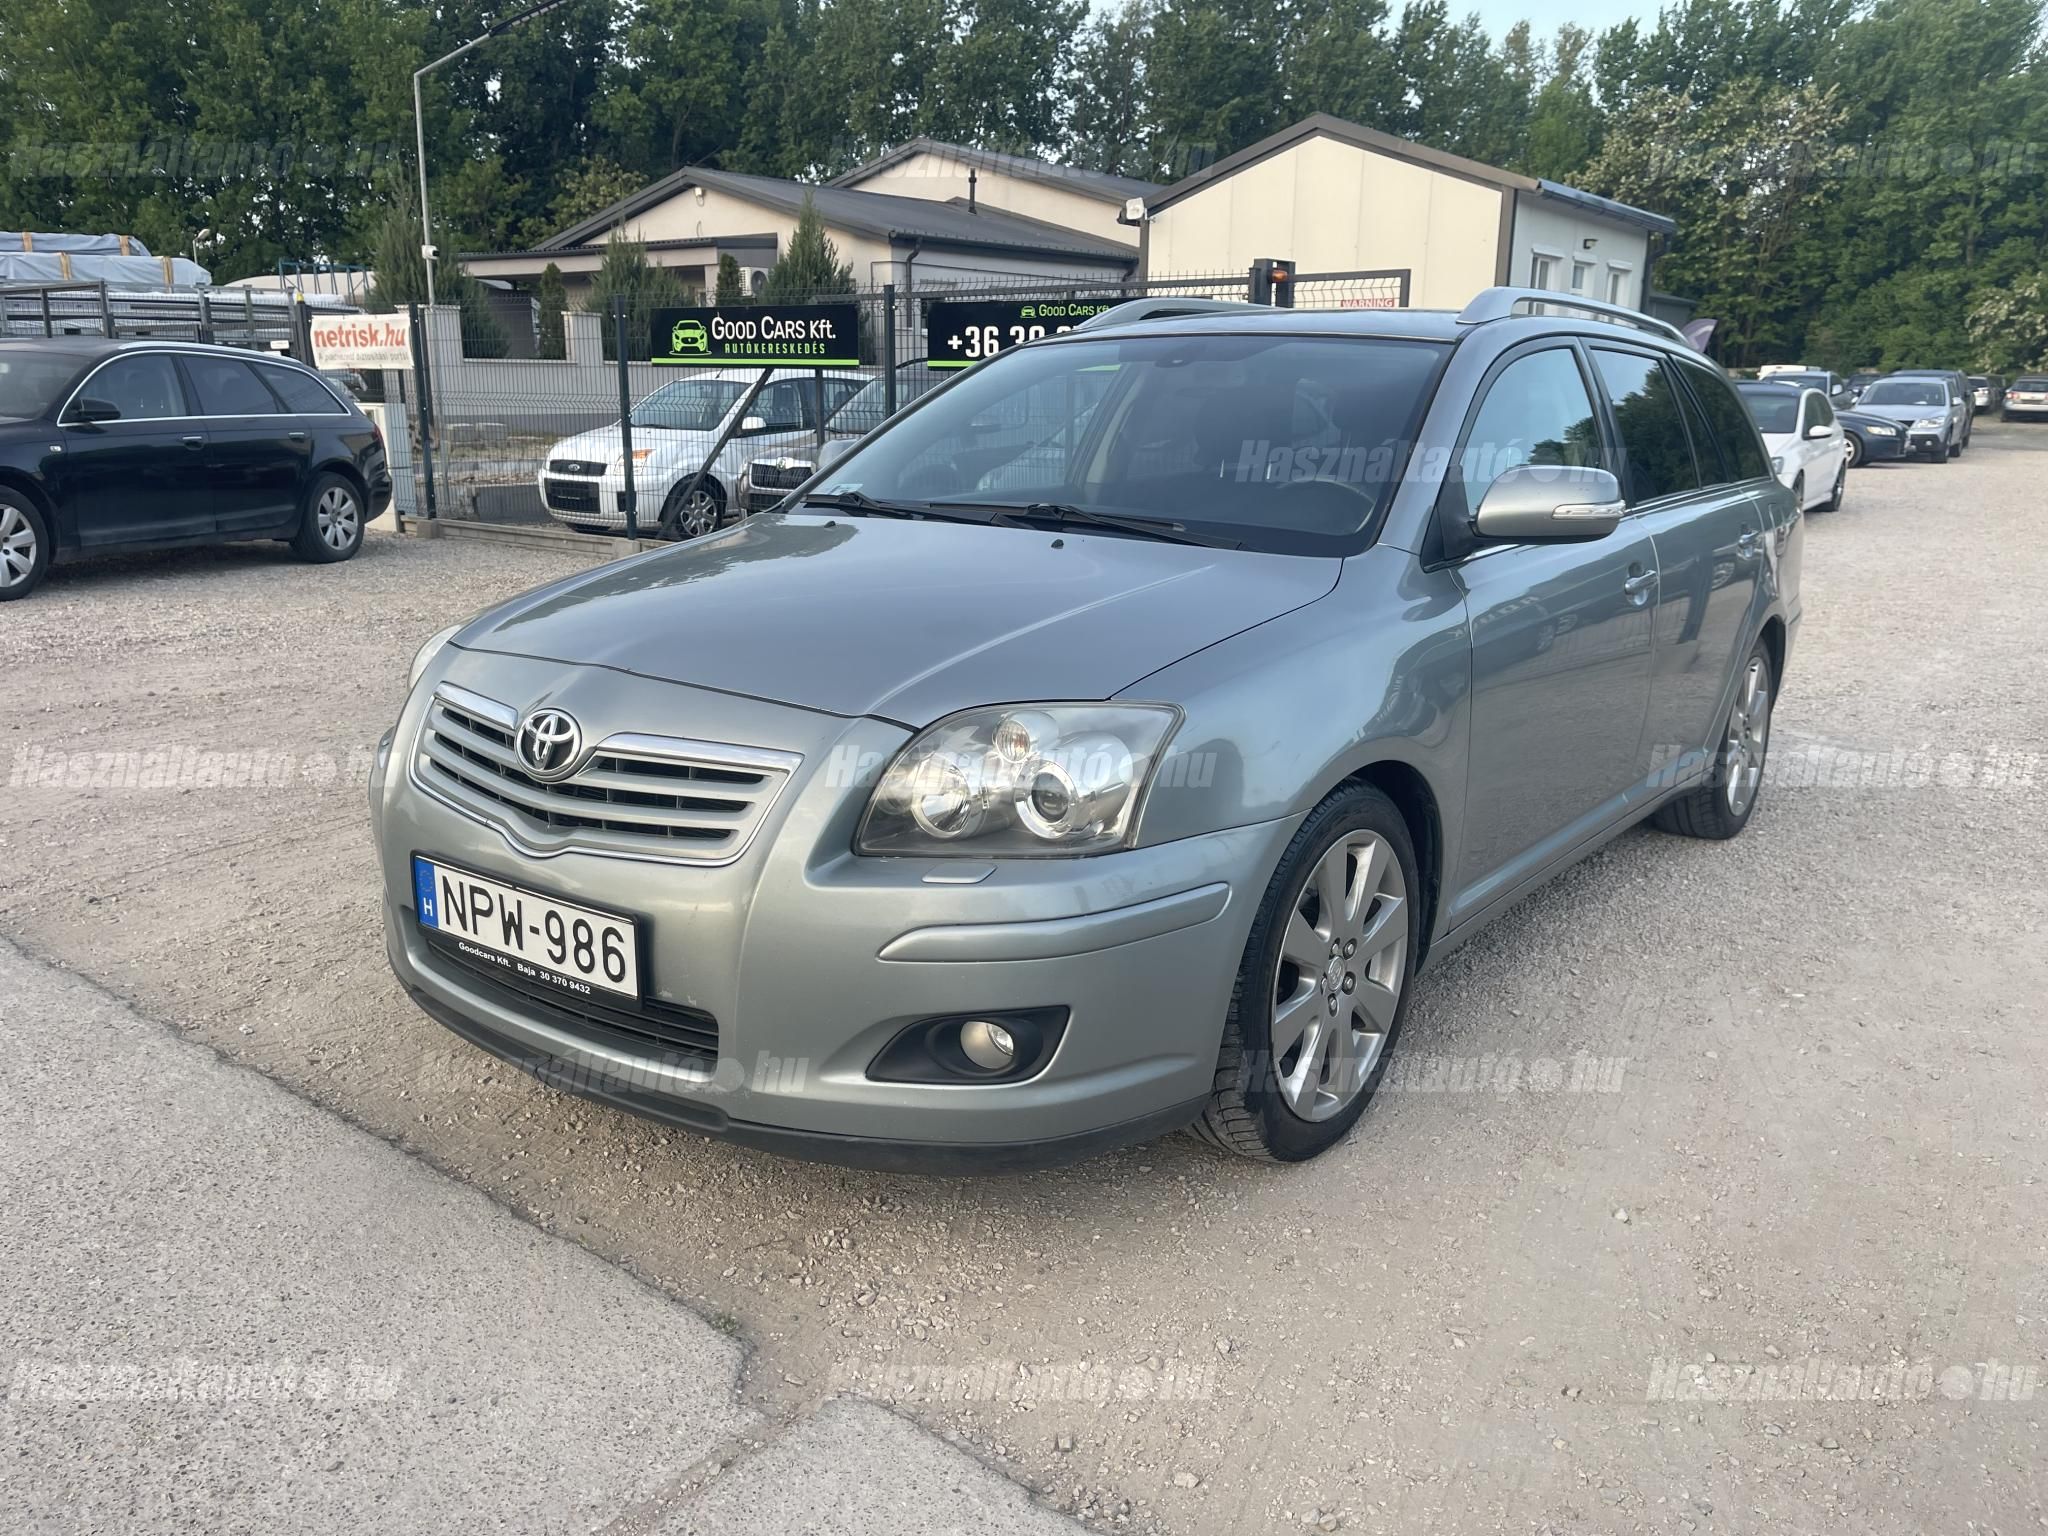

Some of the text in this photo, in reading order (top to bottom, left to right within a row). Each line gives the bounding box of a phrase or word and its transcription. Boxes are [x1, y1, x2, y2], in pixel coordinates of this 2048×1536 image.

[1342, 299, 1395, 308] WARNING
[314, 322, 406, 347] netrisk.hu
[712, 315, 836, 340] GOOD CARS Kft.
[724, 341, 826, 354] AUTÓKERESKEDÉS
[947, 325, 1000, 358] +36
[423, 875, 627, 984] H NPW-986
[458, 941, 591, 995] Goodcars Kft. Baja 30 370 9432
